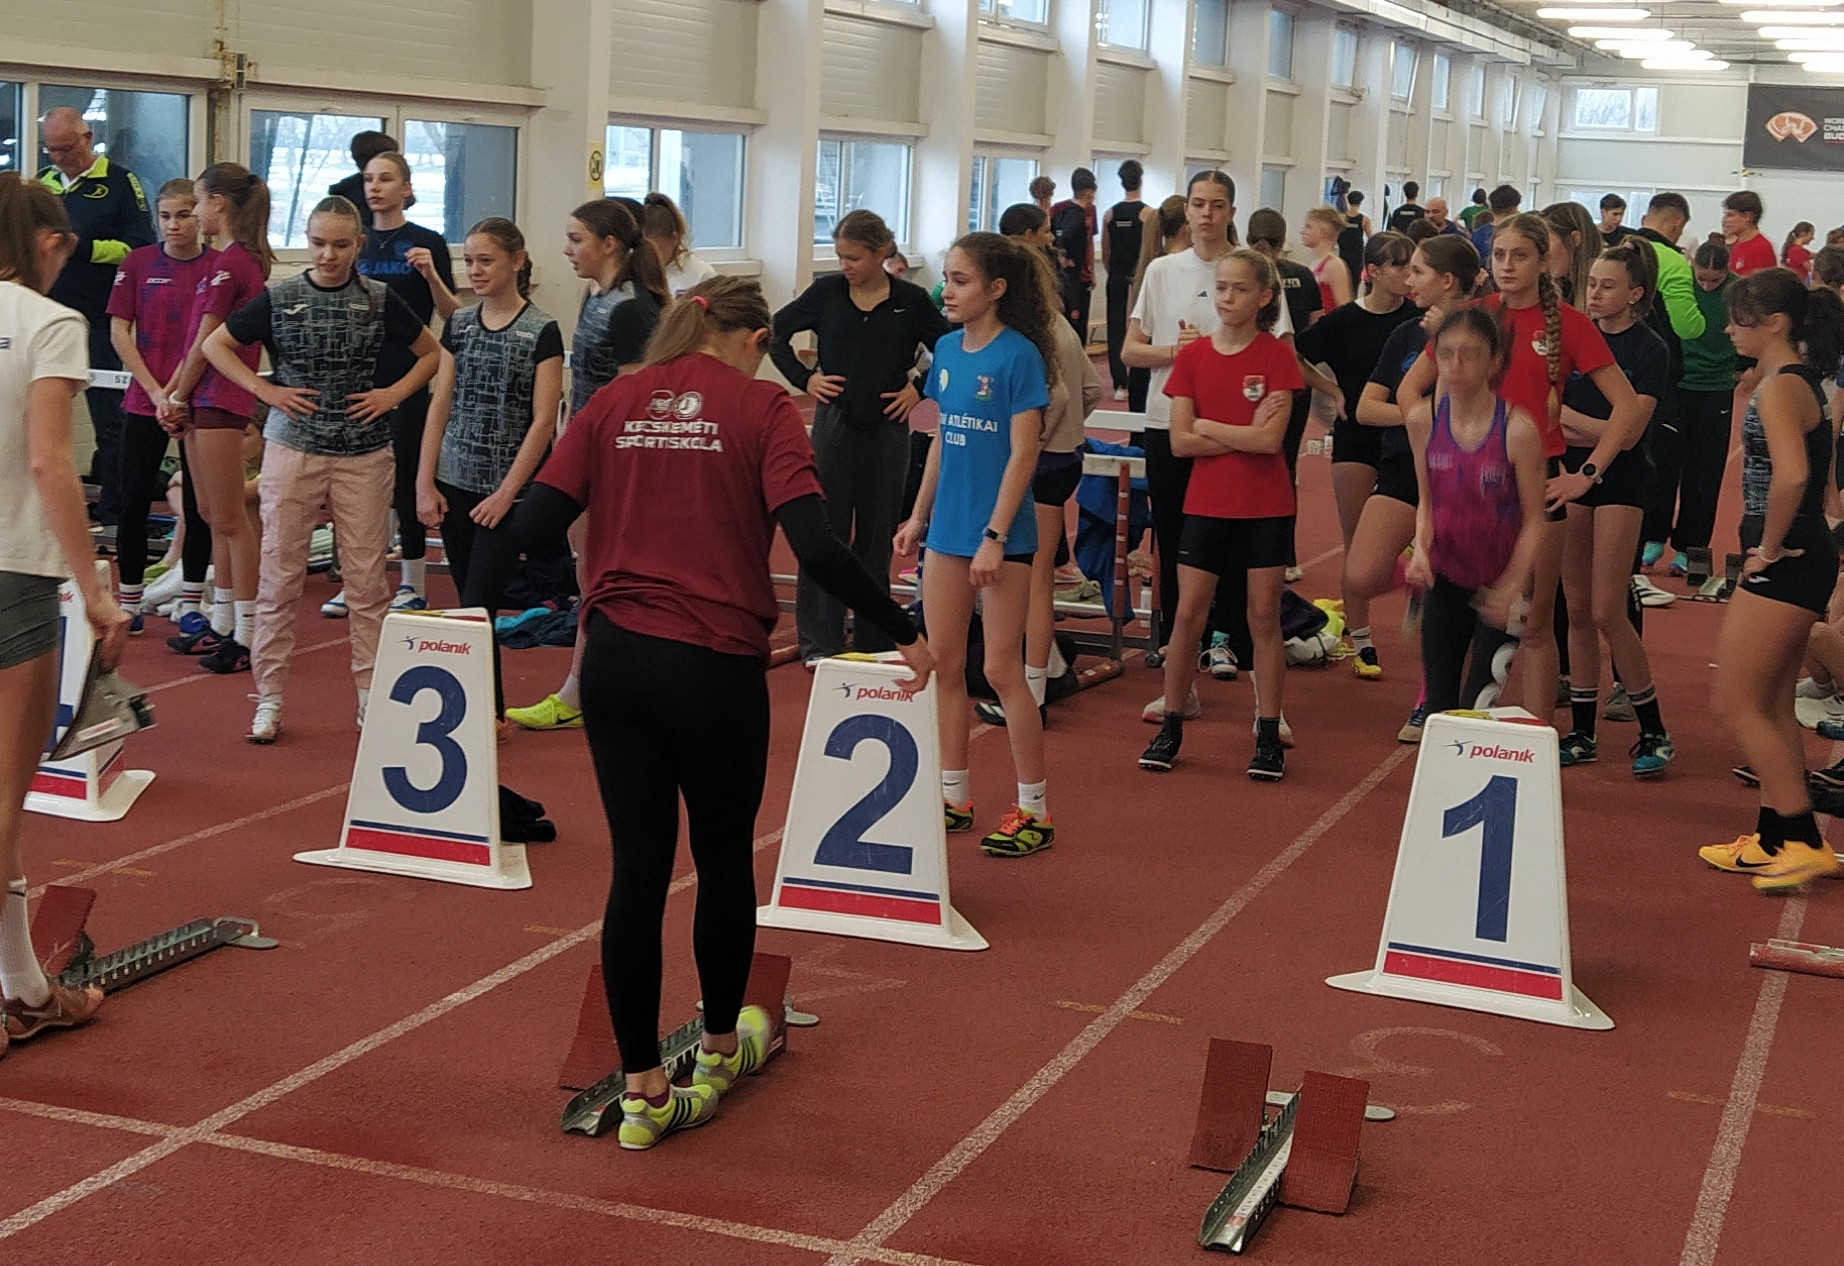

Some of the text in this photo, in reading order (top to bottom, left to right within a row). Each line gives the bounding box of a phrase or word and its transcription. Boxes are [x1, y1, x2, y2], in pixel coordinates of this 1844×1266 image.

[372, 261, 413, 275] JAKO
[948, 412, 998, 432] ATLÉTIKAI
[945, 431, 966, 447] CLUB
[418, 640, 473, 655] polanik
[382, 665, 468, 814] 3
[1469, 744, 1536, 763] polanik
[813, 713, 919, 875] 2
[1442, 774, 1518, 943] 1
